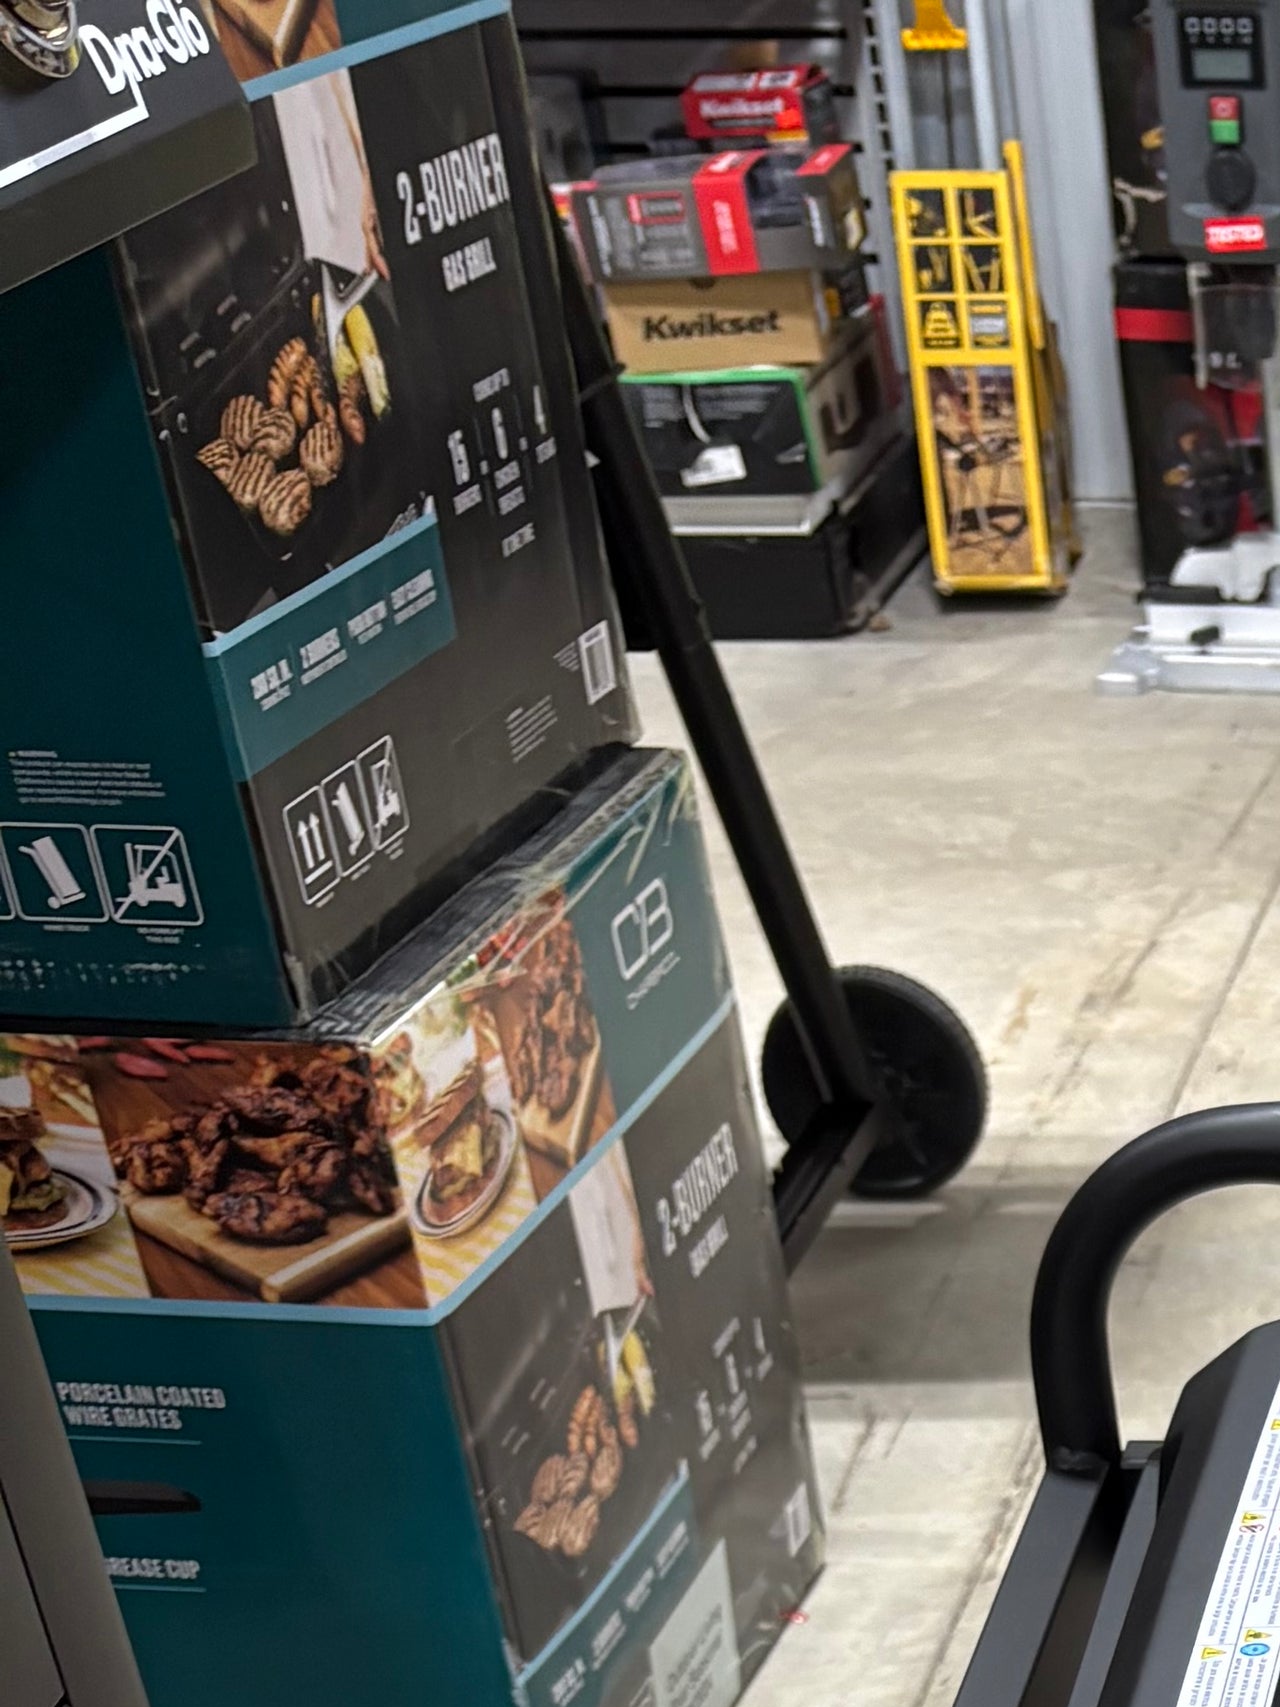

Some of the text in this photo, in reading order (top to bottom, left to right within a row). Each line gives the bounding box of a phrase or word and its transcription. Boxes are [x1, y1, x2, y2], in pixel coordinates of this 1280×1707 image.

[396, 132, 510, 245] 2-BURNER
[643, 310, 779, 341] Kwikset
[56, 1382, 226, 1408] PORCELAIN COATED
[63, 1405, 182, 1430] WIRE GRATES
[105, 1557, 200, 1579] REASE CUP
